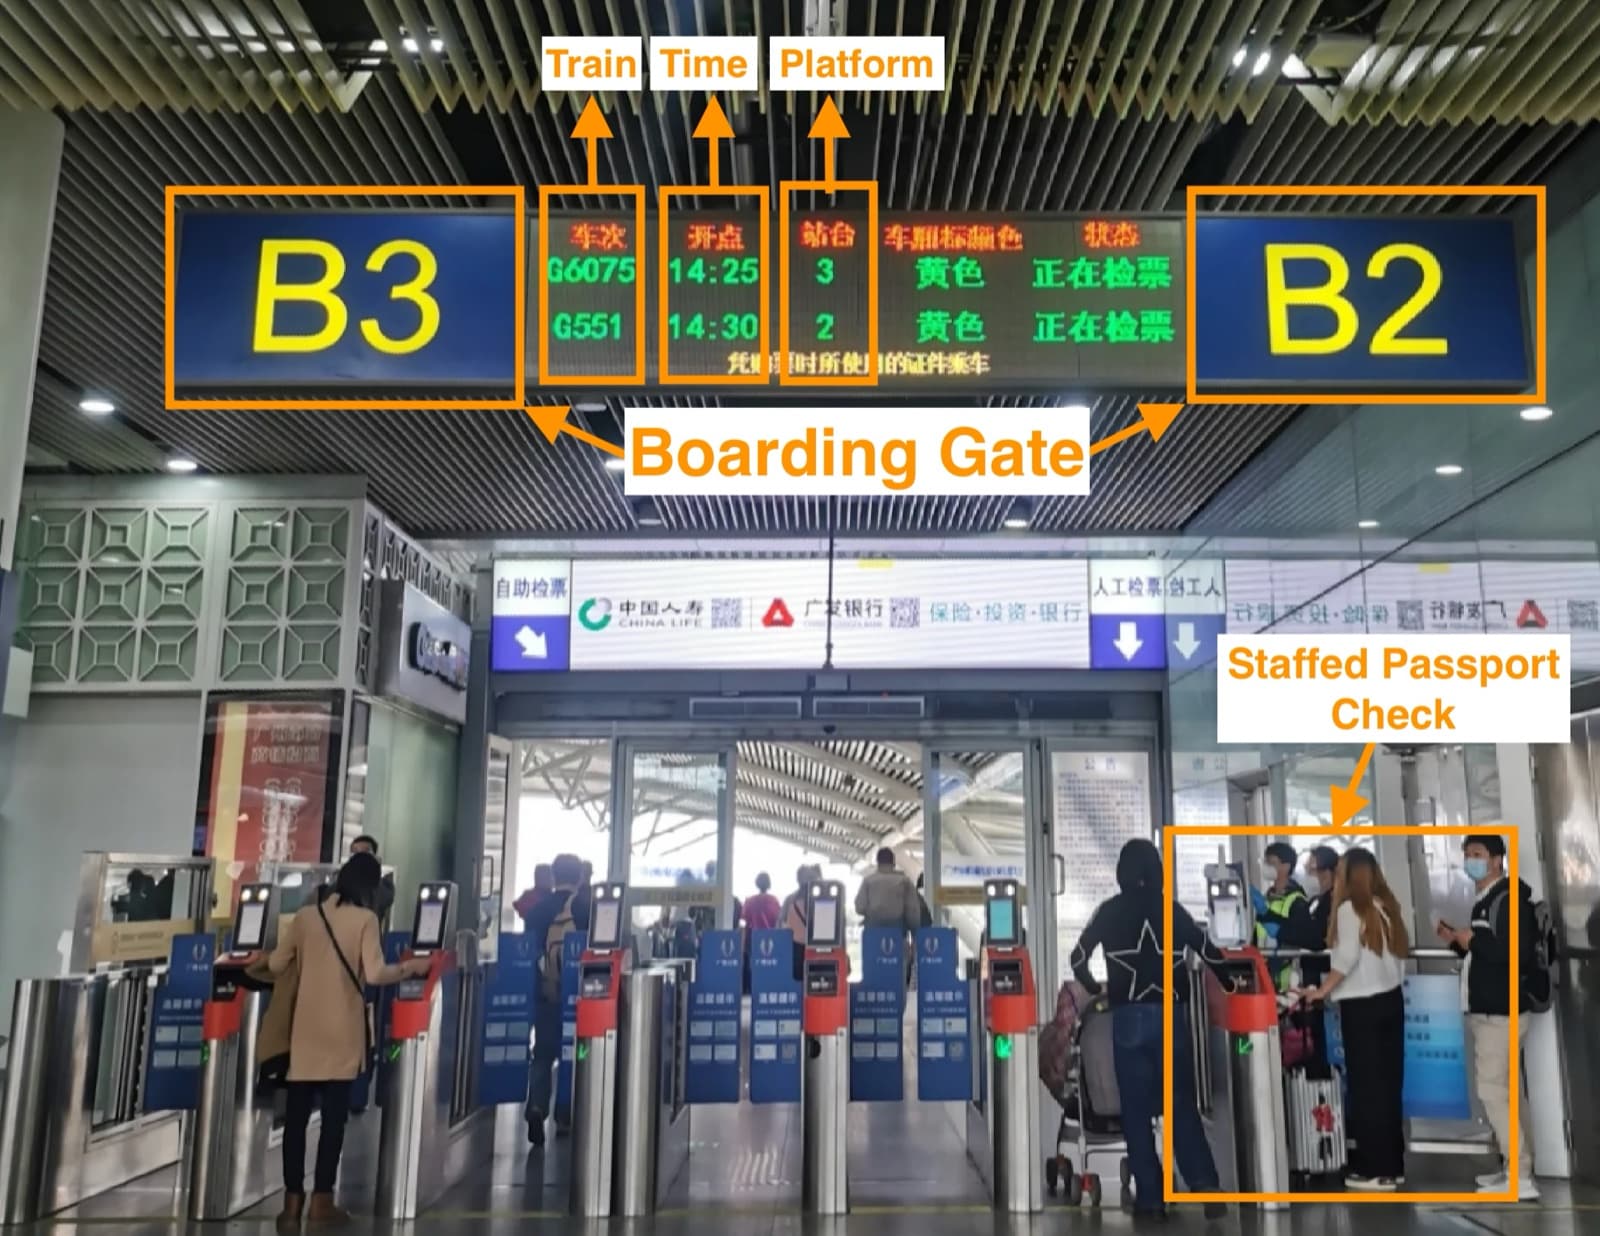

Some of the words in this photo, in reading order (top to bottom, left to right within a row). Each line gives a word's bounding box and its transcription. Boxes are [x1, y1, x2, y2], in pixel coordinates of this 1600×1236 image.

[570, 224, 627, 250] 车次
[688, 224, 744, 250] 开点
[800, 221, 855, 247] 站台
[1083, 221, 1140, 248] 状态
[547, 257, 636, 283] G6075
[669, 257, 760, 283] 14:25
[816, 257, 834, 284] 3
[916, 256, 986, 289] 黄色
[1032, 256, 1173, 289] 正在检票
[253, 239, 440, 354] B3
[1265, 243, 1448, 354] B2
[552, 314, 622, 340] G551
[669, 313, 759, 340] 14:30
[816, 314, 834, 341] 2
[916, 311, 986, 344] 黄色
[1032, 311, 1175, 343] 正在检票
[495, 577, 567, 599] 自助检票
[1093, 577, 1162, 598] 人工检票
[619, 599, 703, 616] 中国人寿
[804, 598, 882, 617] 广发银行
[618, 618, 665, 628] CHINA
